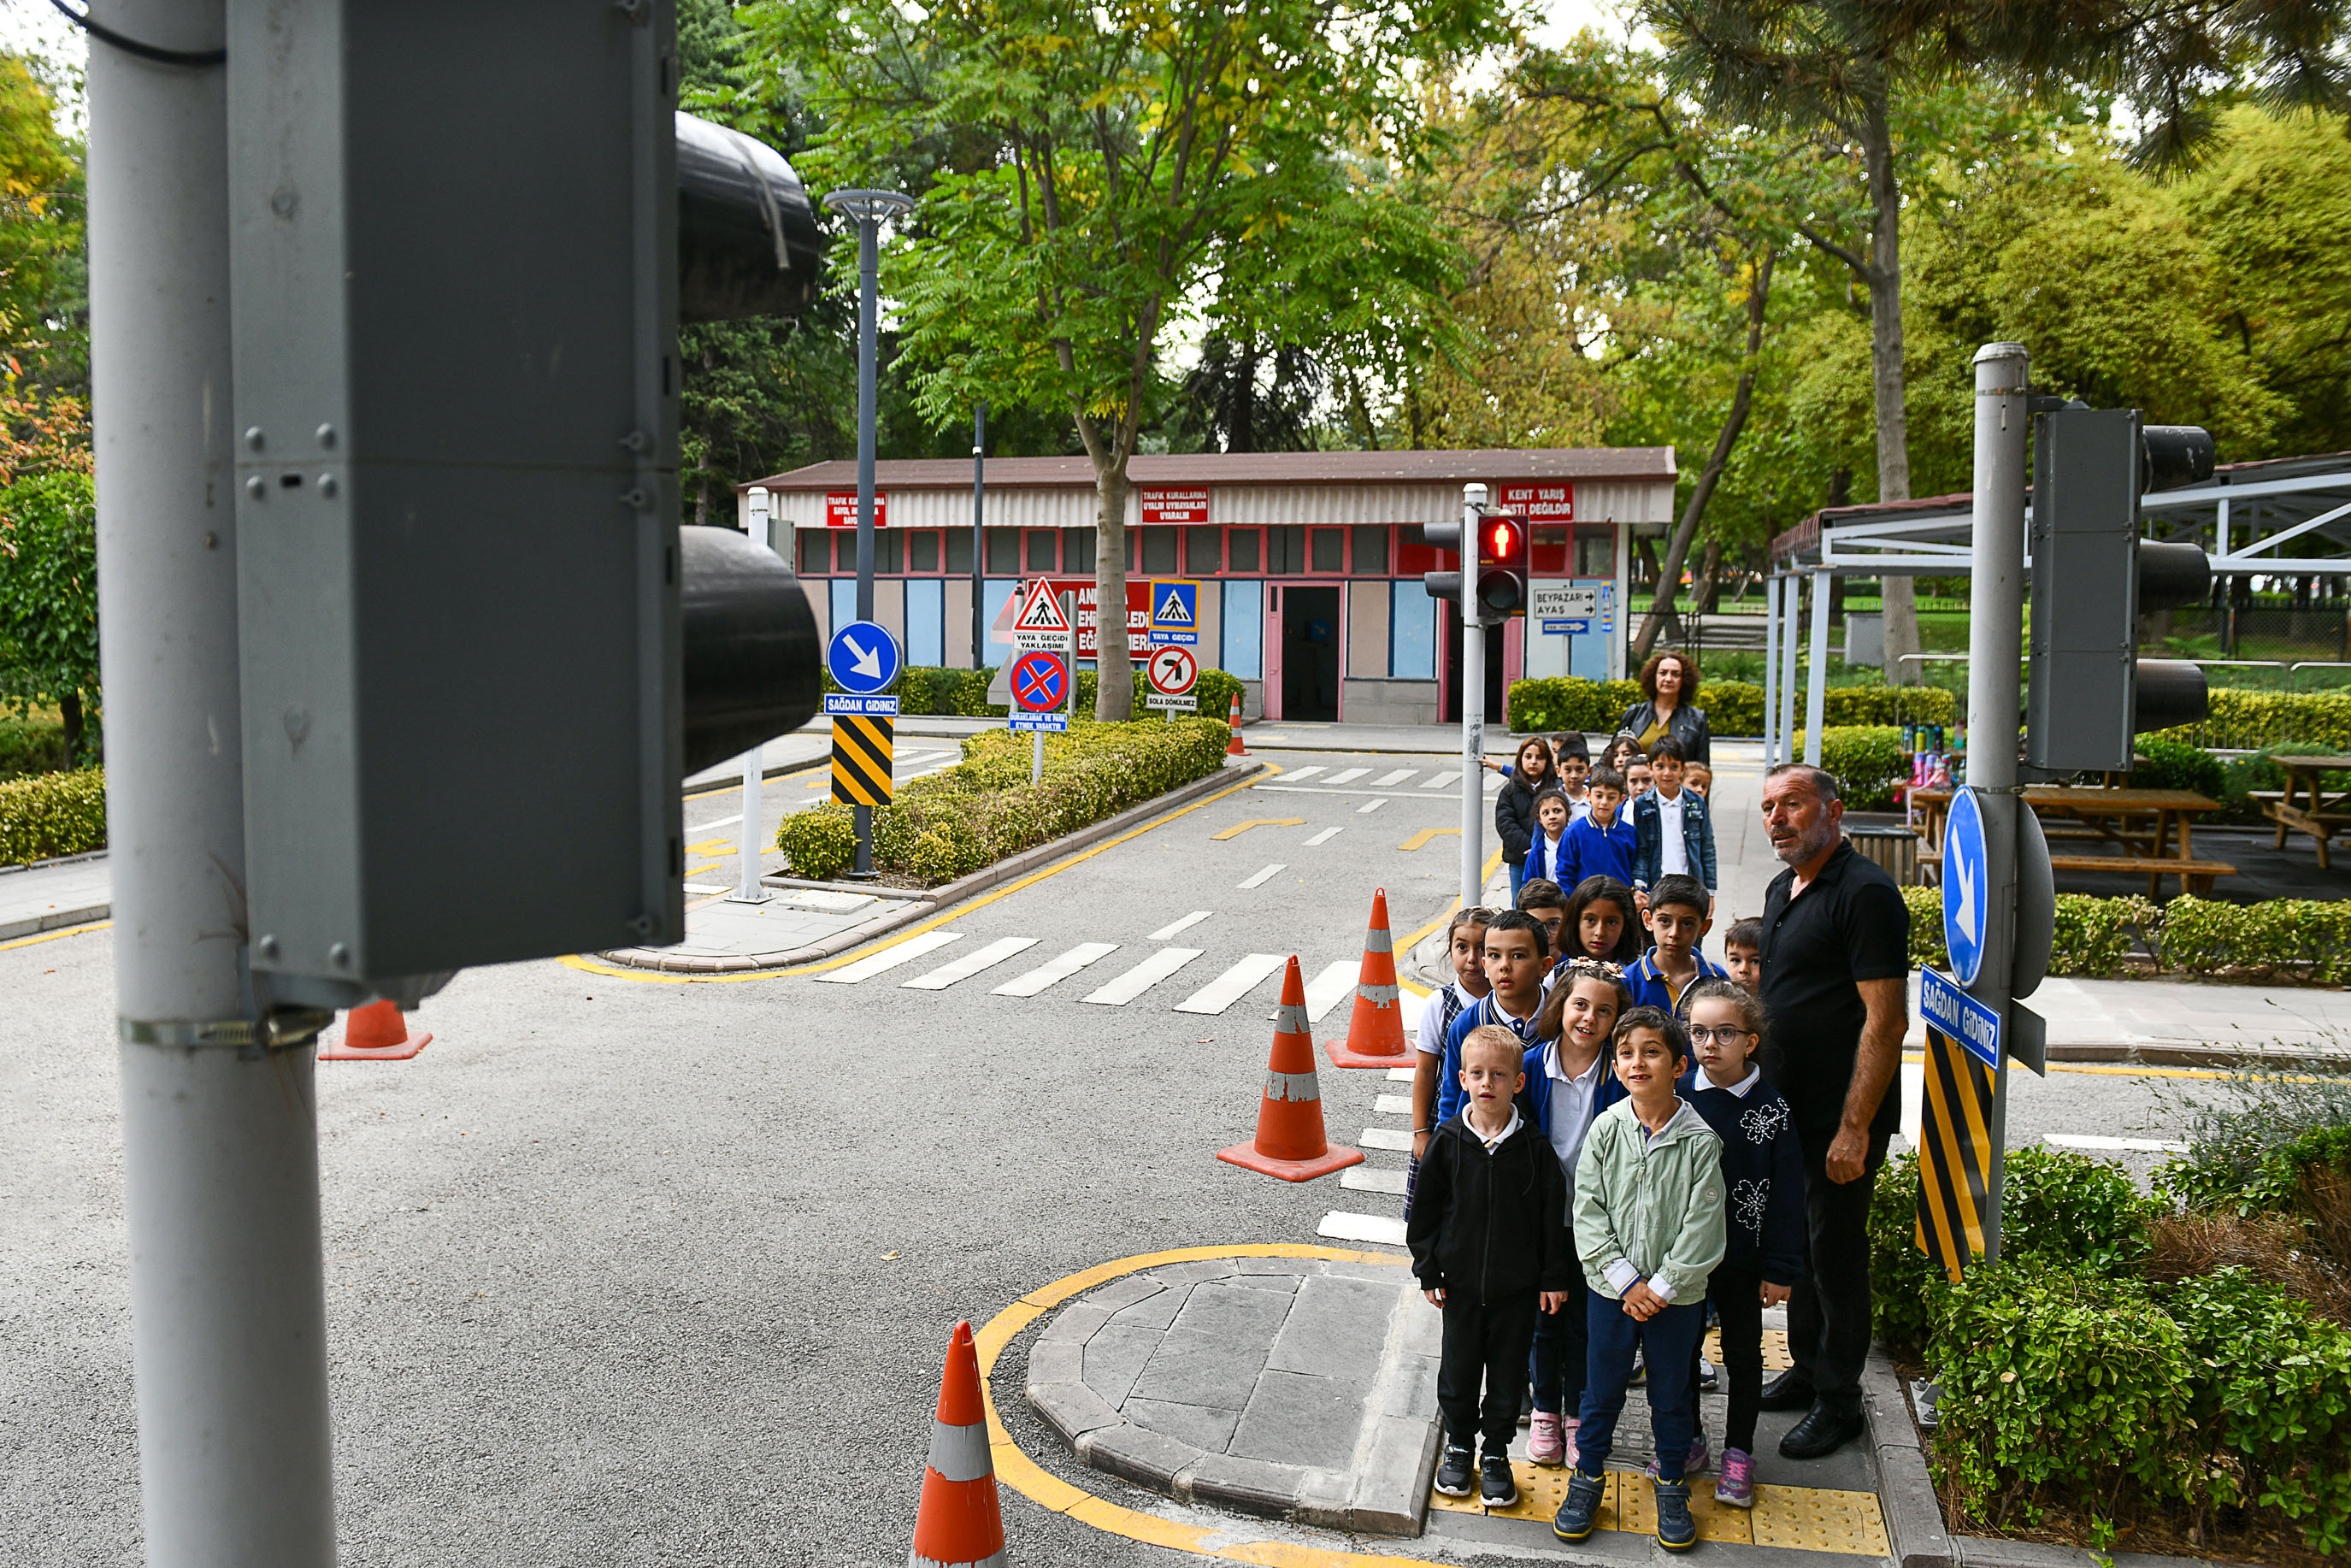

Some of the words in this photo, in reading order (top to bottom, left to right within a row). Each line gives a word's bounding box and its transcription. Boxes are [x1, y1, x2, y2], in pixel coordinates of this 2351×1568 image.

[1508, 489, 1534, 500] KENT
[1538, 488, 1565, 502] YARIŞ
[1529, 501, 1570, 515] DEĞİLDİR
[1536, 592, 1583, 603] BEYPAZARI
[1537, 605, 1565, 615] AYAŞ
[1171, 634, 1195, 642] GEÇİDİ
[828, 697, 862, 711] SAĞDAN
[865, 699, 896, 712] GİDİNİZ
[1165, 698, 1195, 706] DÖNÜLMEZ
[1044, 714, 1052, 722] VE
[1923, 980, 1959, 1028] SAĞDAN
[1962, 1005, 1996, 1055] GİDİNİZ
